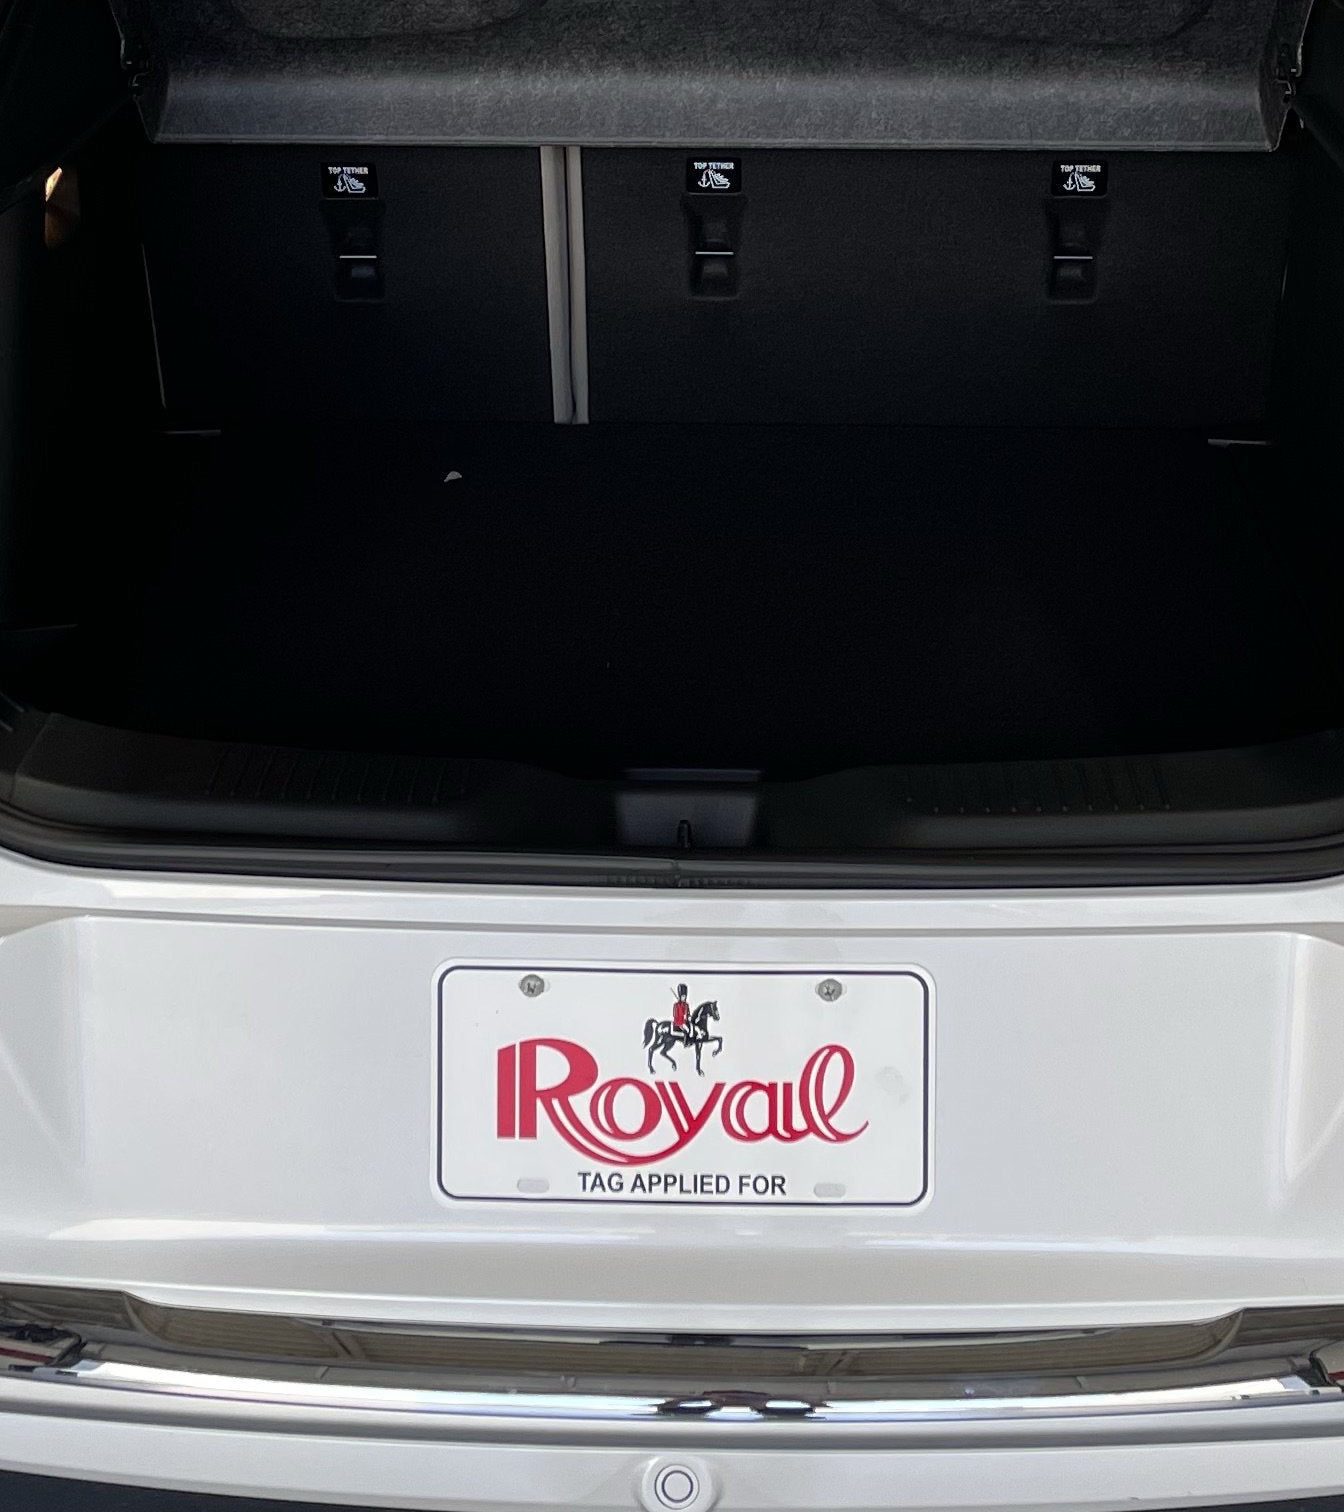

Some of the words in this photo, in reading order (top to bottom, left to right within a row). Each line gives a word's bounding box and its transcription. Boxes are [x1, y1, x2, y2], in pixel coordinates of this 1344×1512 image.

[327, 166, 342, 175] TOP
[342, 166, 369, 175] TETHER
[693, 162, 707, 170] TOP
[708, 162, 735, 170] TETHER
[1060, 164, 1074, 173] TOP
[1074, 164, 1102, 173] TETHER
[495, 1036, 870, 1167] Royal
[577, 1170, 625, 1194] TAG
[629, 1172, 732, 1196] APPLIED
[737, 1175, 788, 1197] FOR
